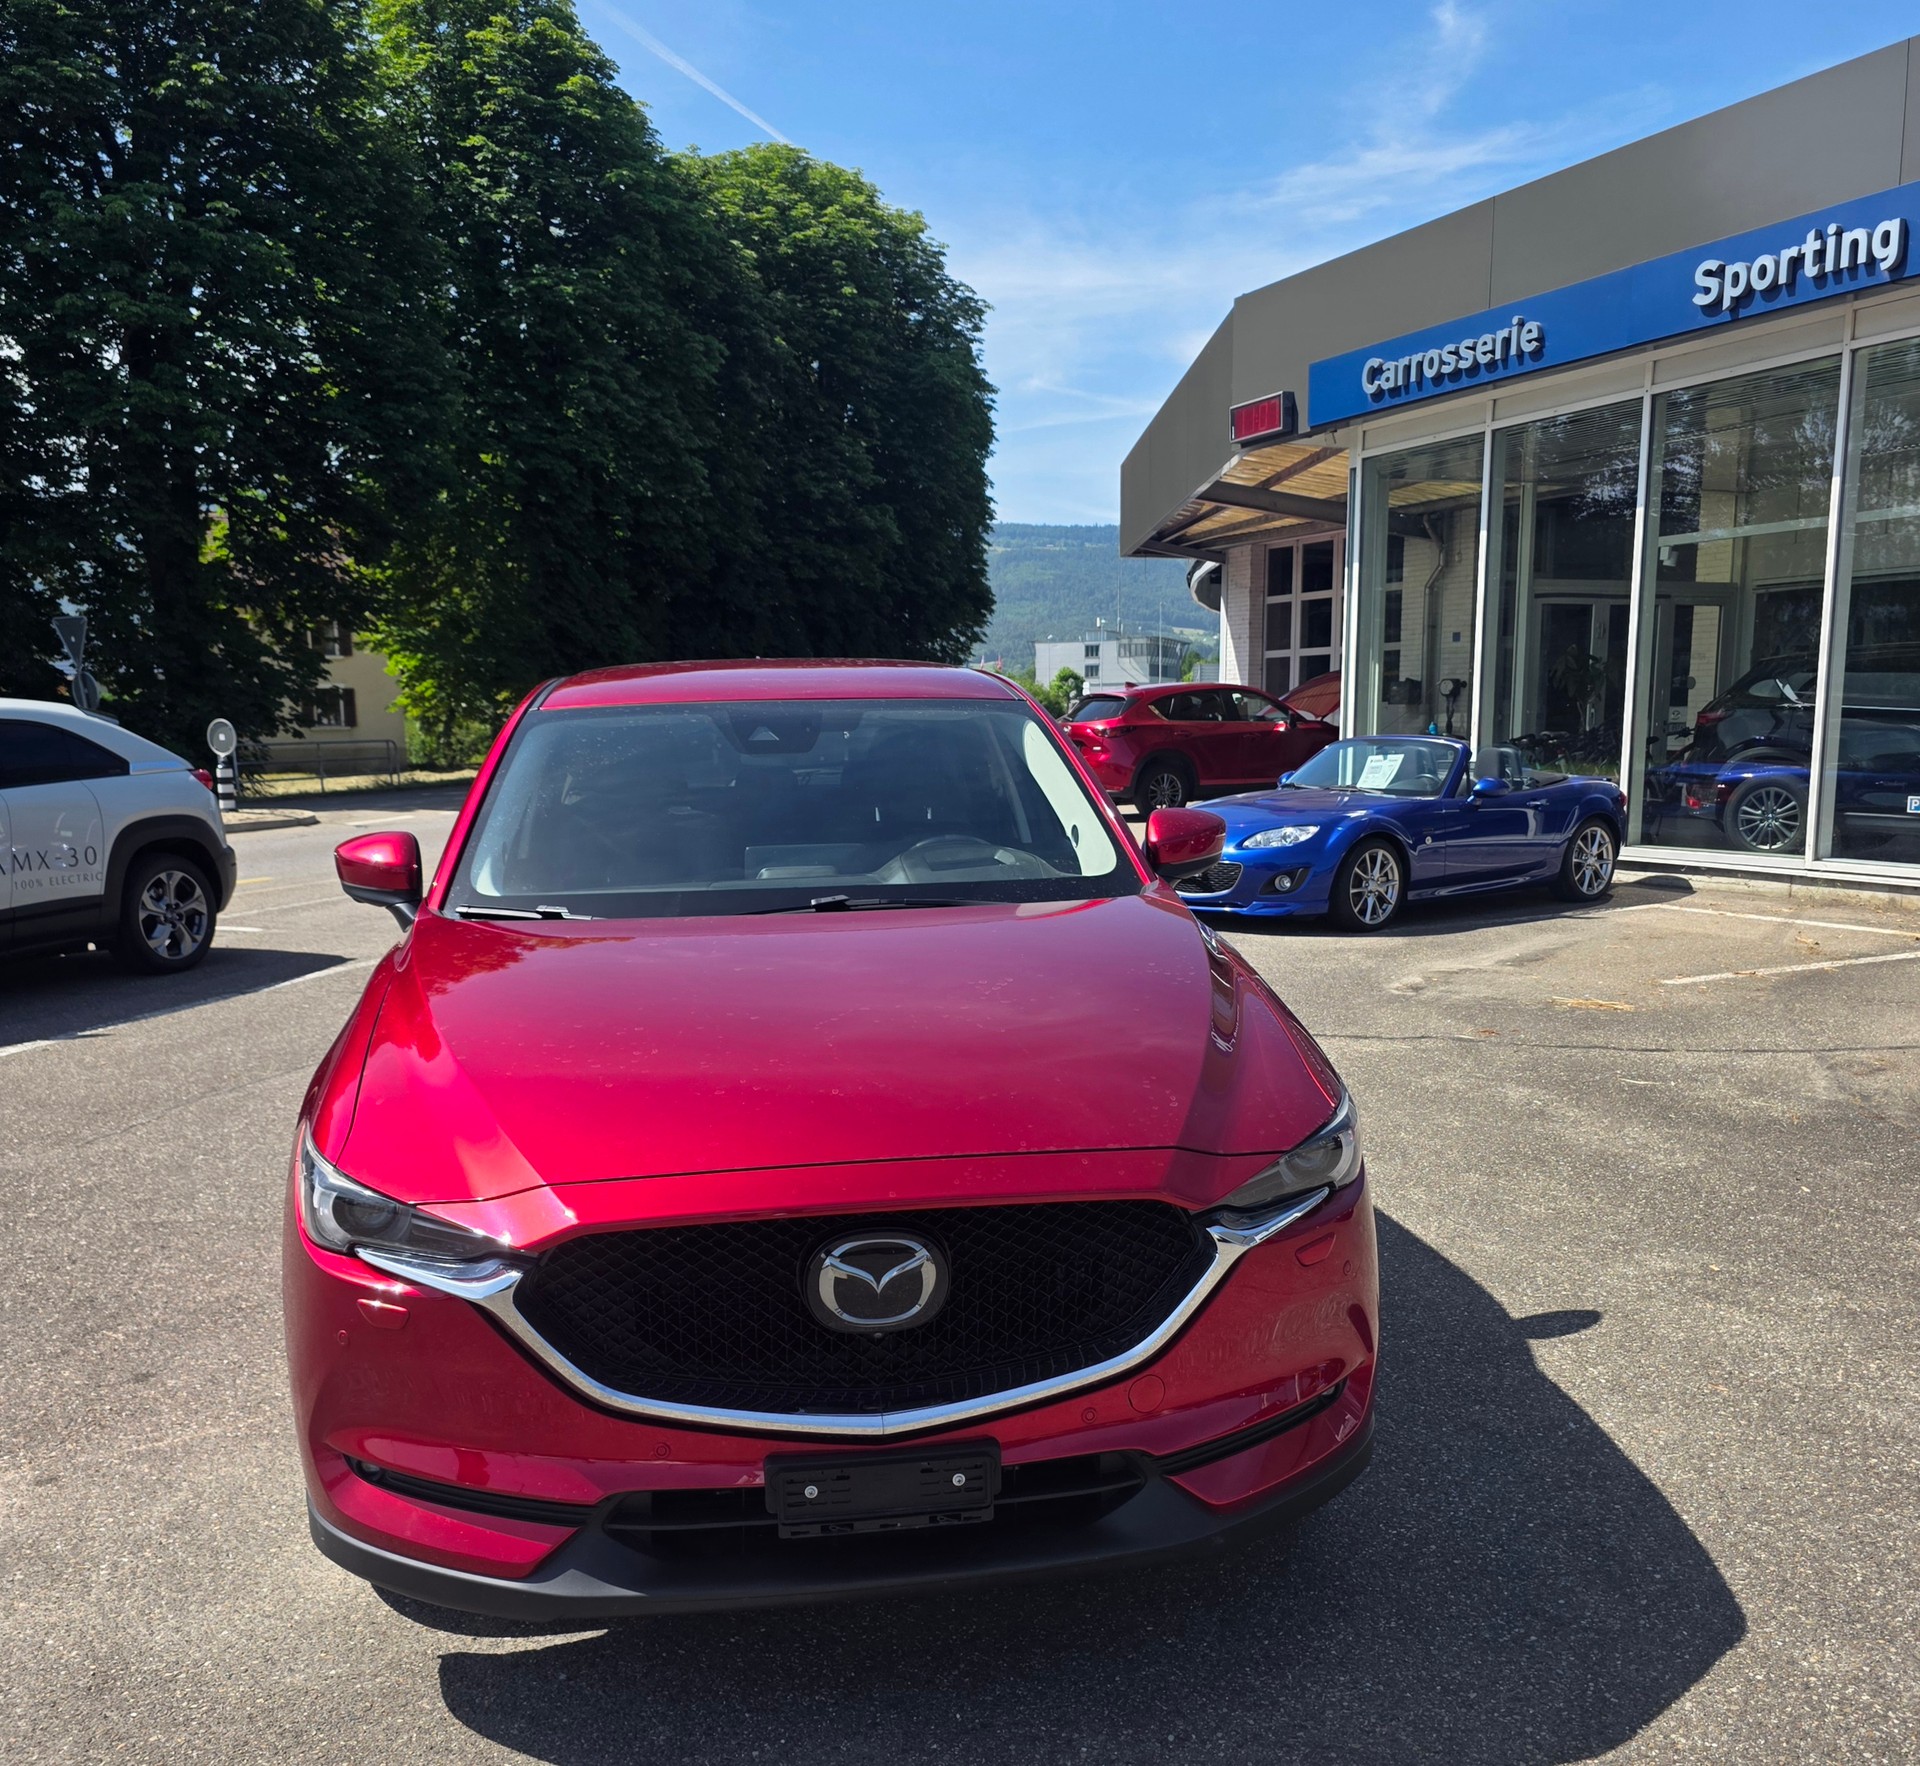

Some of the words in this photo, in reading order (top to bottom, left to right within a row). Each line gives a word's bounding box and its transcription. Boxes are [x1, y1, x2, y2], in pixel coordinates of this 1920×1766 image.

[1362, 316, 1543, 394] Carrosserie
[1692, 217, 1906, 310] Sporting
[12, 846, 97, 873] MX-30
[14, 879, 44, 890] 100%
[49, 871, 104, 887] ELECTRIC
